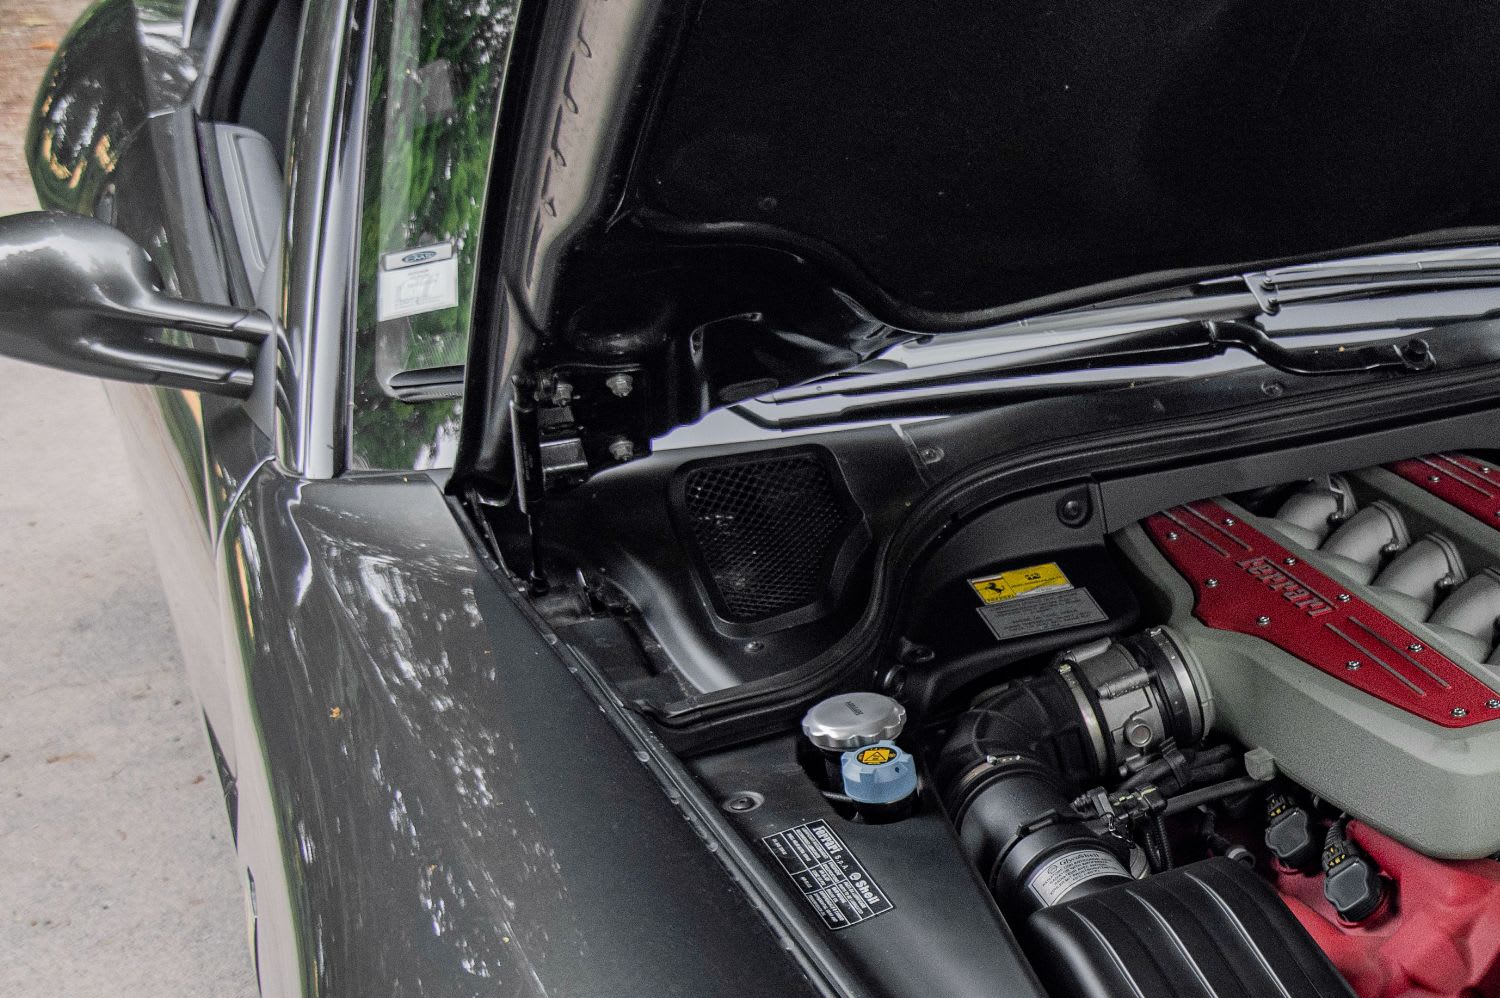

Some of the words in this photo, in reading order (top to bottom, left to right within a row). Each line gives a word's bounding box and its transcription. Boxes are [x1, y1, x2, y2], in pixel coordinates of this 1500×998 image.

[1236, 555, 1339, 618] Ferrari
[812, 825, 844, 854] Ferrari
[855, 878, 880, 905] Shell
